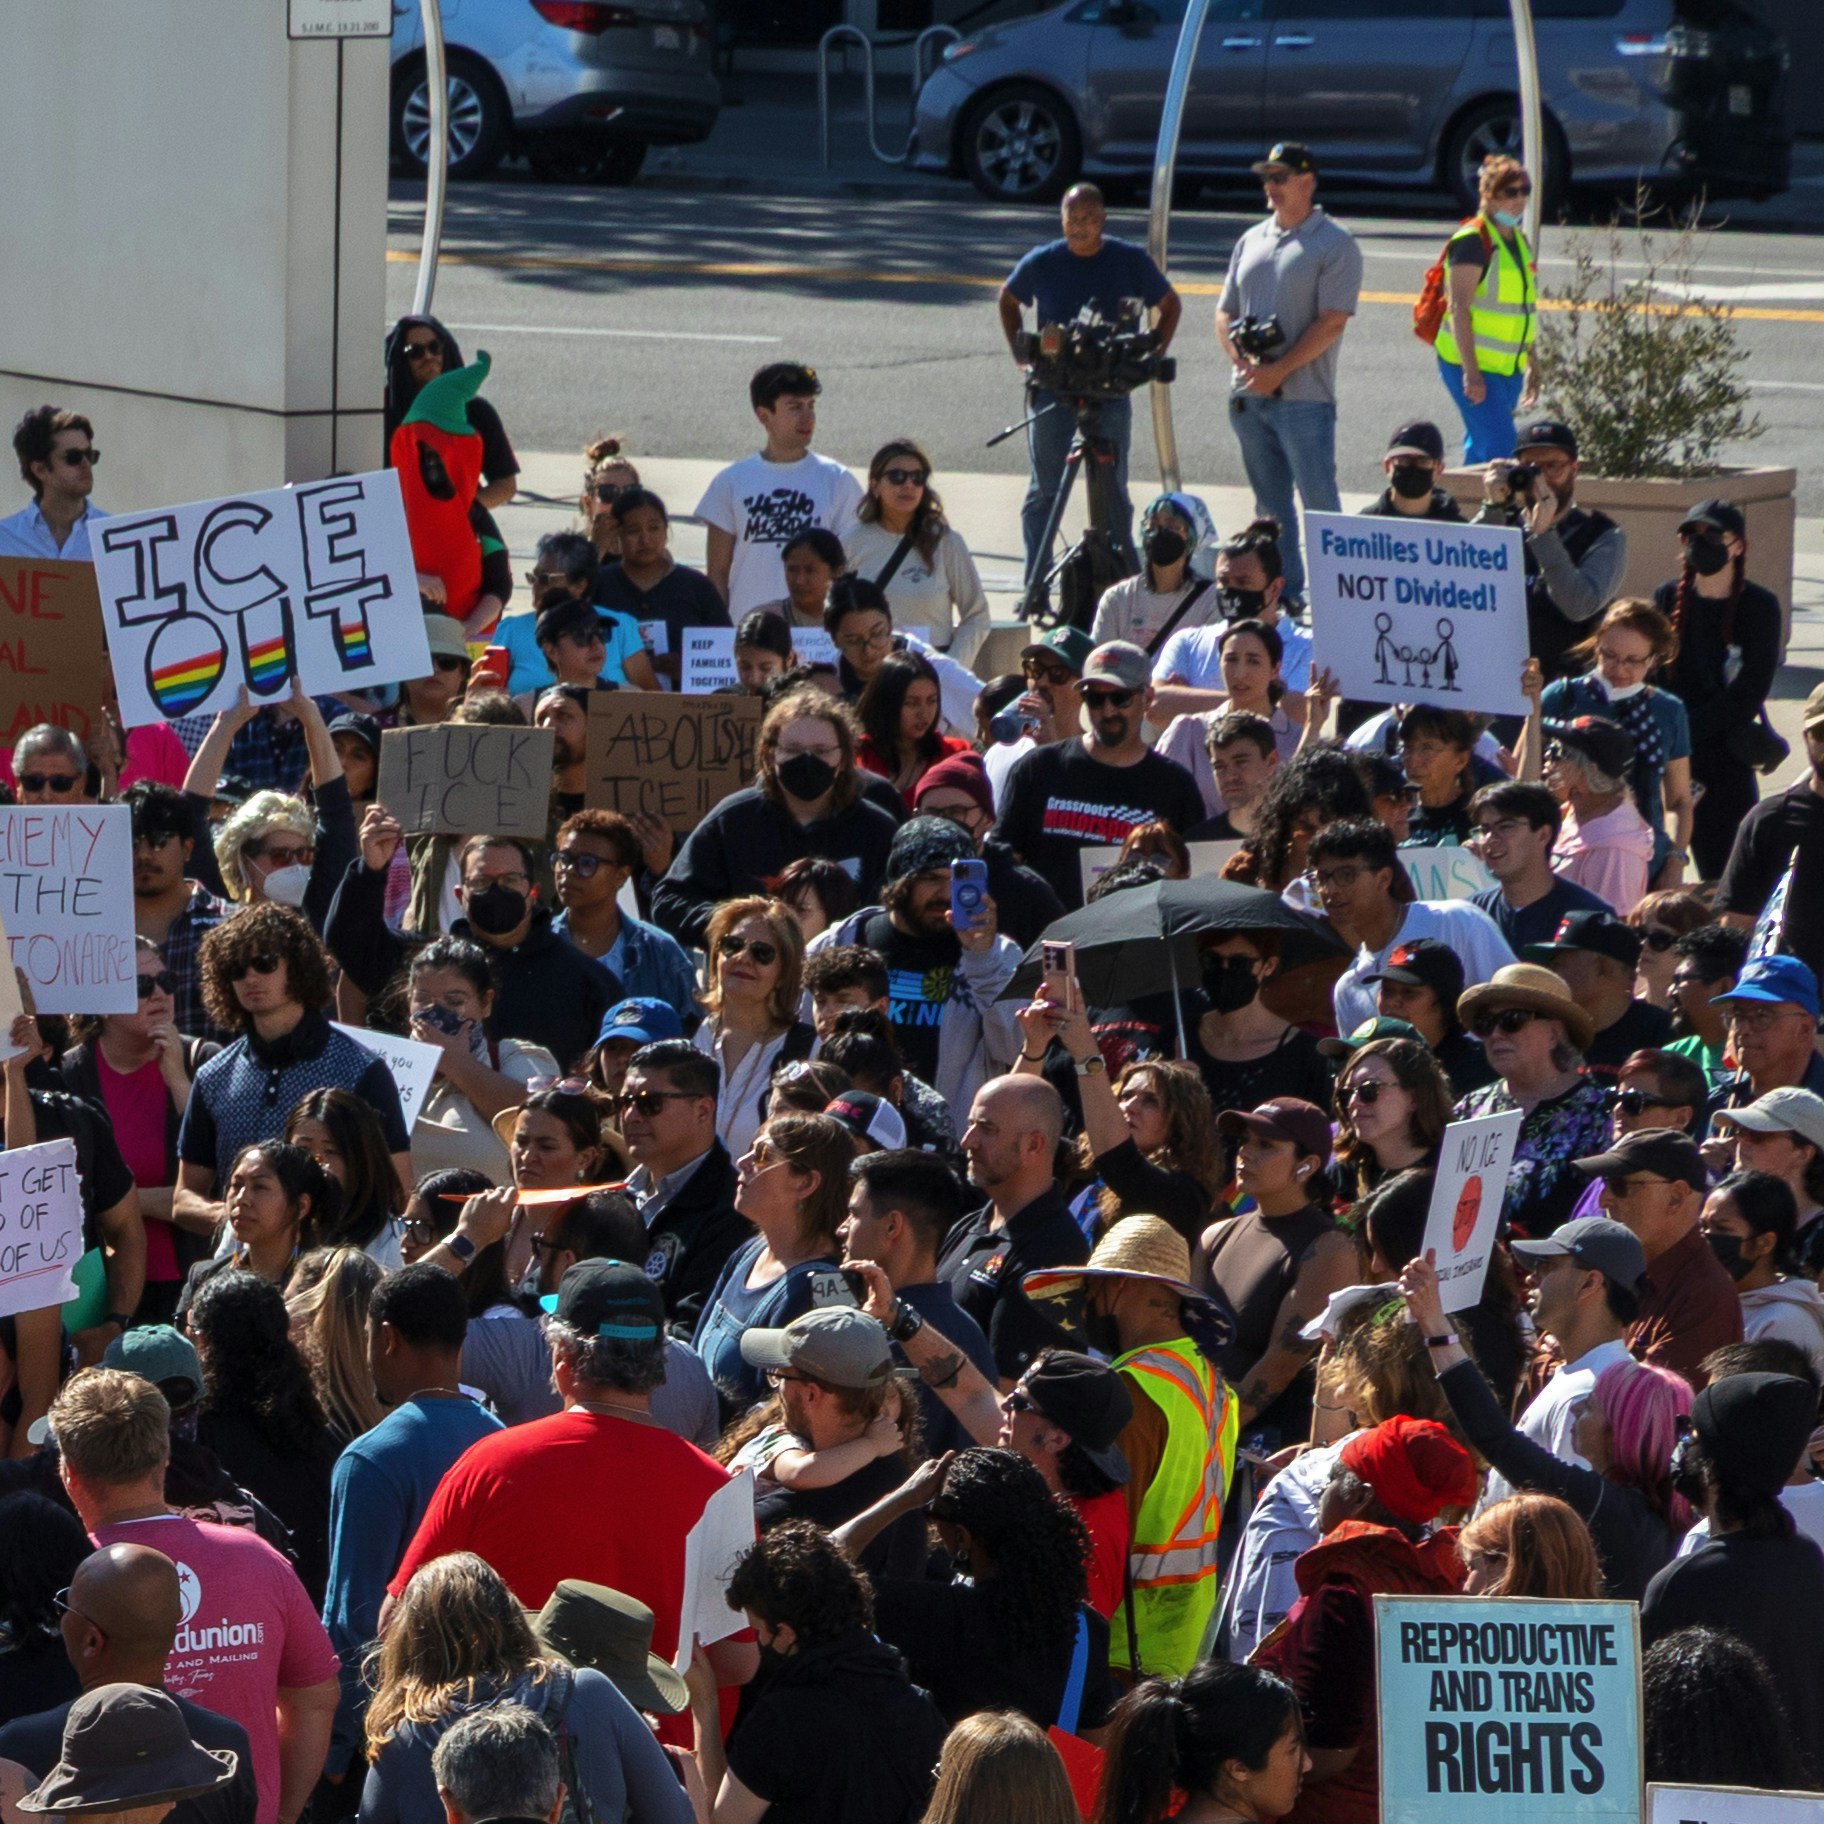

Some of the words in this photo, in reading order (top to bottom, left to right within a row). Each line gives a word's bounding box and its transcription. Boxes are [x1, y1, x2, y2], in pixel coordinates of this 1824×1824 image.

[102, 481, 370, 627] ICE
[1321, 529, 1419, 563] Families
[1425, 538, 1508, 571] United
[1338, 573, 1388, 601] NOT
[1395, 577, 1497, 612] Divided!
[145, 575, 392, 718] OUT
[691, 640, 714, 650] KEEP
[691, 658, 731, 669] FAMILIES
[406, 730, 533, 792] FUCK
[405, 783, 524, 834] ICE
[1048, 797, 1109, 817] Grassroots
[3, 873, 102, 916] THE
[1455, 1136, 1477, 1174] NO
[22, 1164, 73, 1194] GET
[21, 1203, 48, 1231] OF
[0, 1243, 31, 1272] OF
[40, 1231, 72, 1262] US
[177, 1659, 204, 1669] AND
[1401, 1622, 1617, 1666] REPRODUCTIVE
[1429, 1672, 1491, 1713] AND
[1499, 1672, 1595, 1713] TRANS
[1426, 1722, 1604, 1794] RIGHTS
